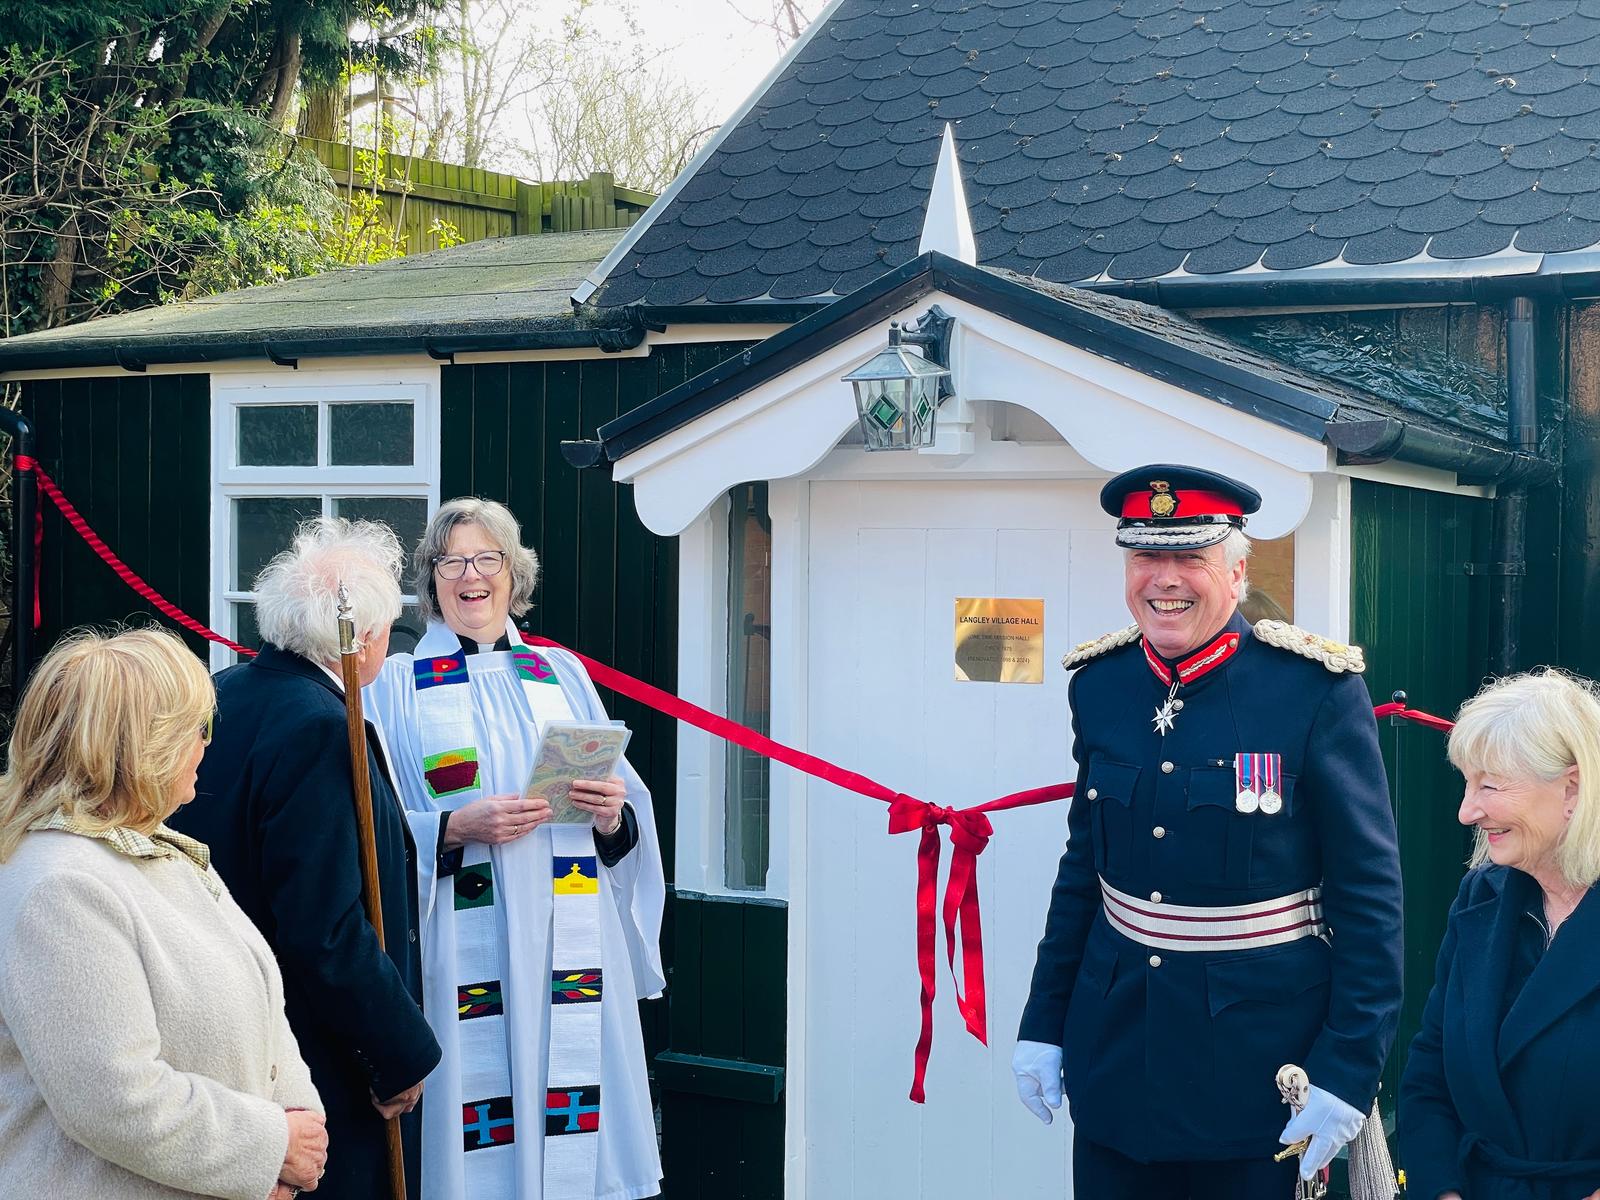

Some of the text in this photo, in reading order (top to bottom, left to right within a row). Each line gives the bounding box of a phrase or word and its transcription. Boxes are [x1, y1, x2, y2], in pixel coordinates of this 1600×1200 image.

[959, 616, 1039, 625] LANGLEY VILLAGE HALL
